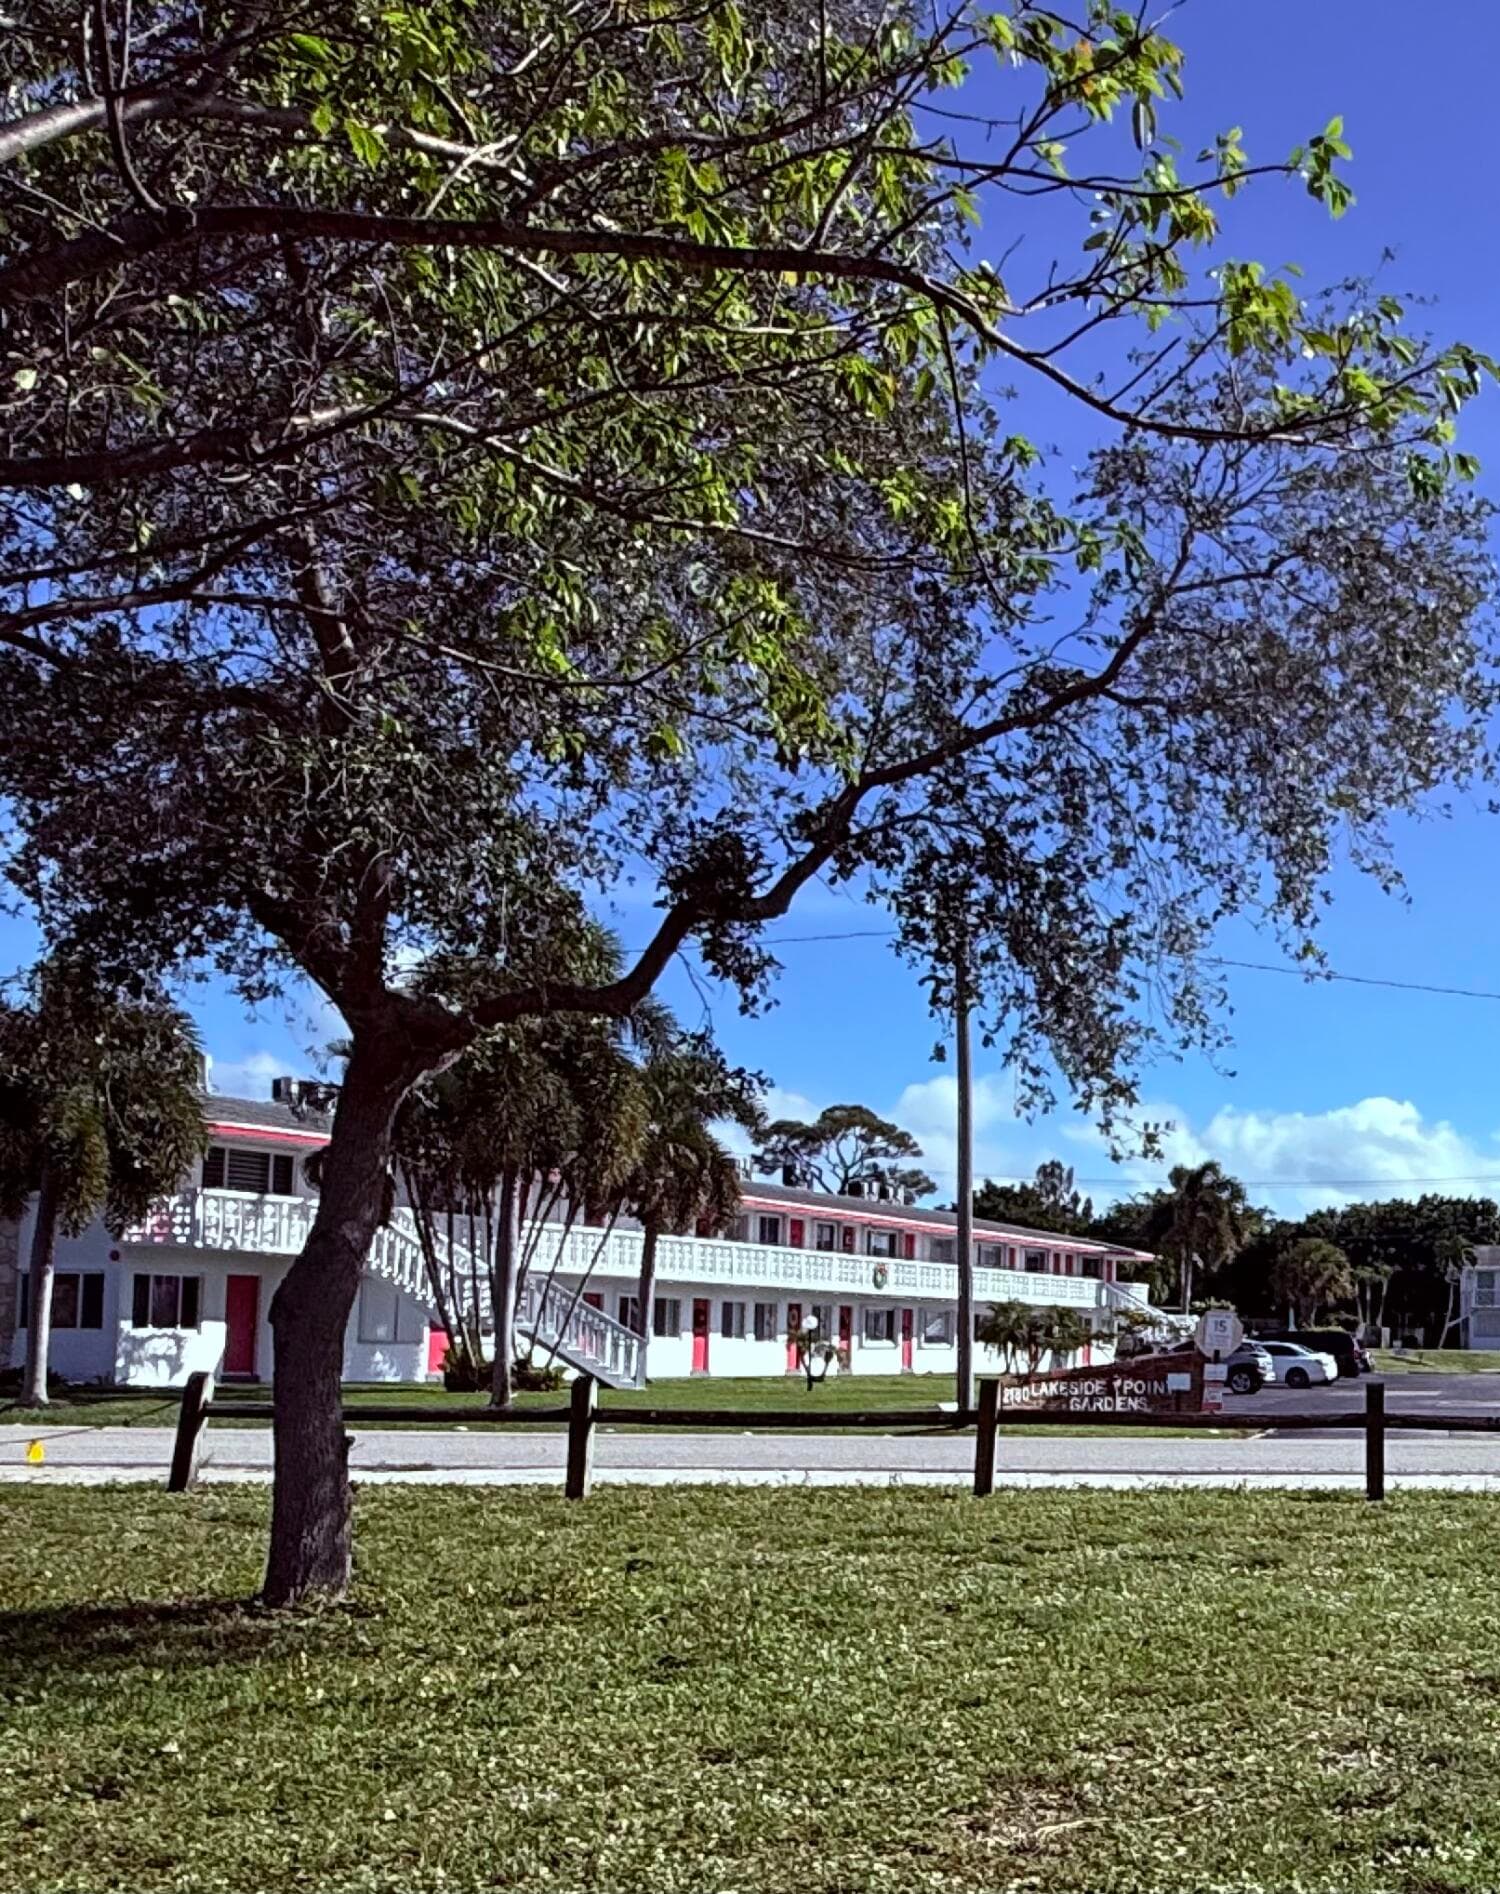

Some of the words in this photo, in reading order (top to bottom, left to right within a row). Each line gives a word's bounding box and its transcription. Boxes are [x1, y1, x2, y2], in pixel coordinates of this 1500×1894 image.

[1214, 1319, 1227, 1332] 15
[1031, 1380, 1107, 1397] LAKESIDE
[1070, 1396, 1149, 1412] GARDENS
